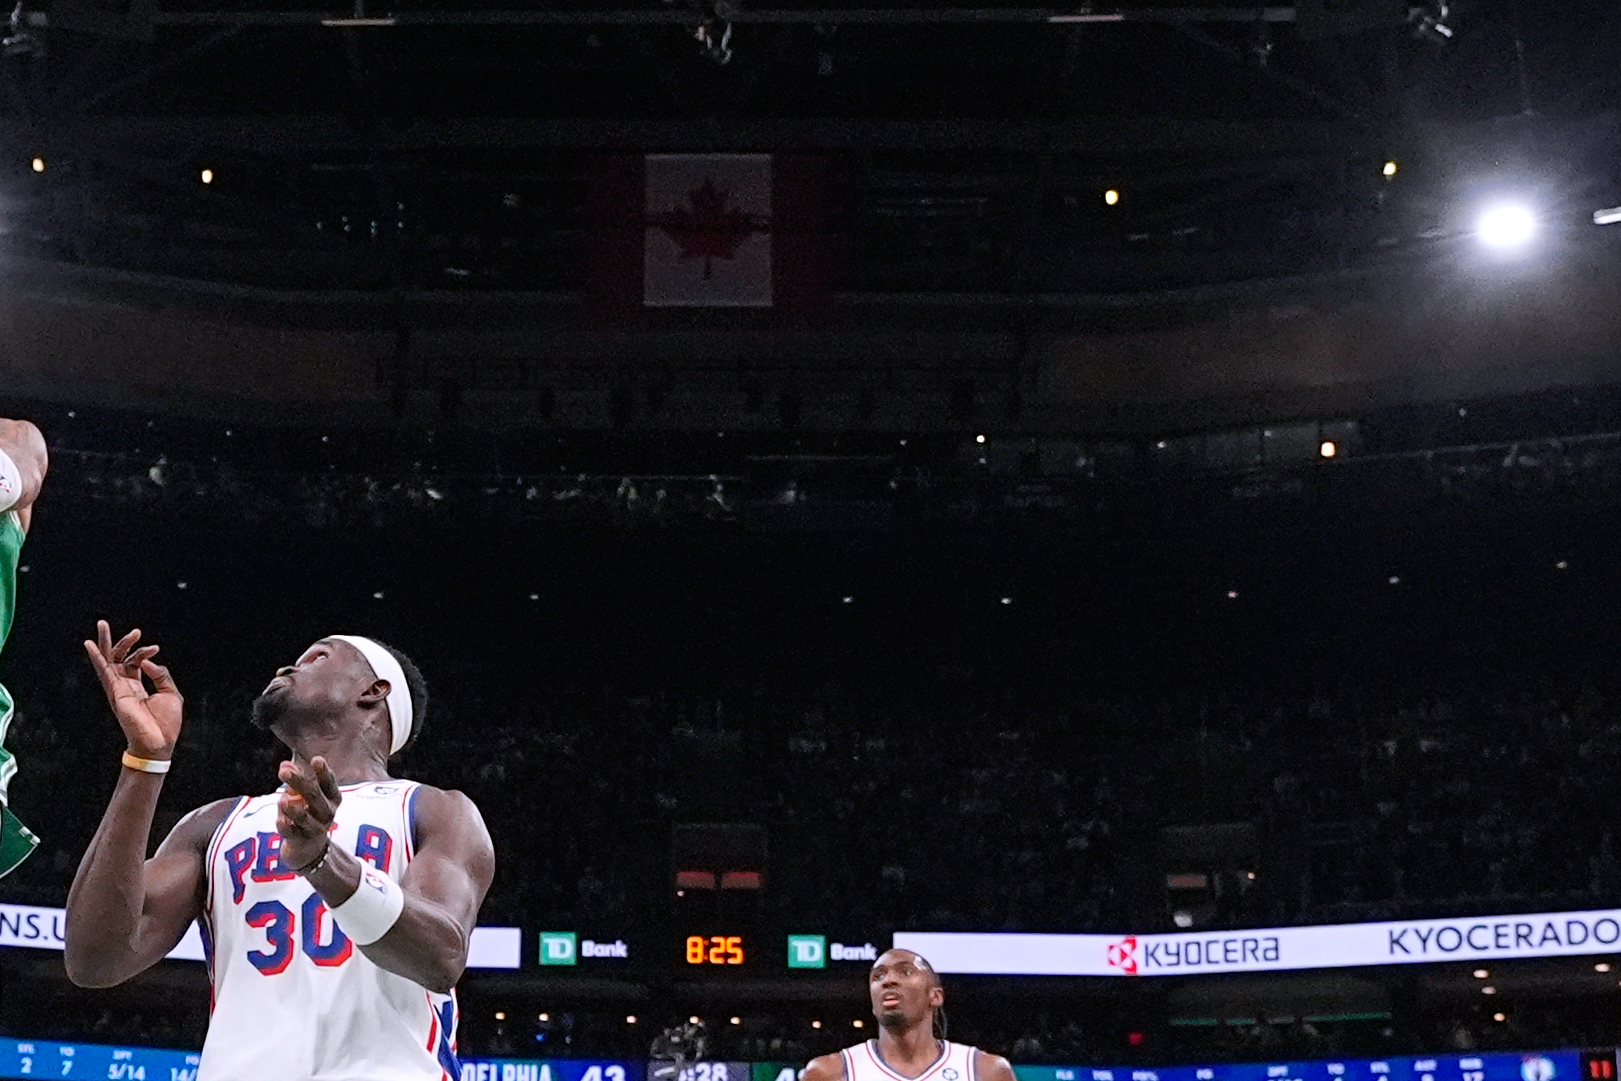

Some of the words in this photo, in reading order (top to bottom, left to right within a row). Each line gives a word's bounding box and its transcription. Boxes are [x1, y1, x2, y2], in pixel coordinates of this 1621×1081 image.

[224, 822, 394, 906] PHA
[245, 889, 354, 977] 30
[581, 940, 627, 958] Bank
[1388, 917, 1621, 955] KYOCERADO
[686, 936, 744, 965] 8:25
[830, 942, 878, 961] Bank
